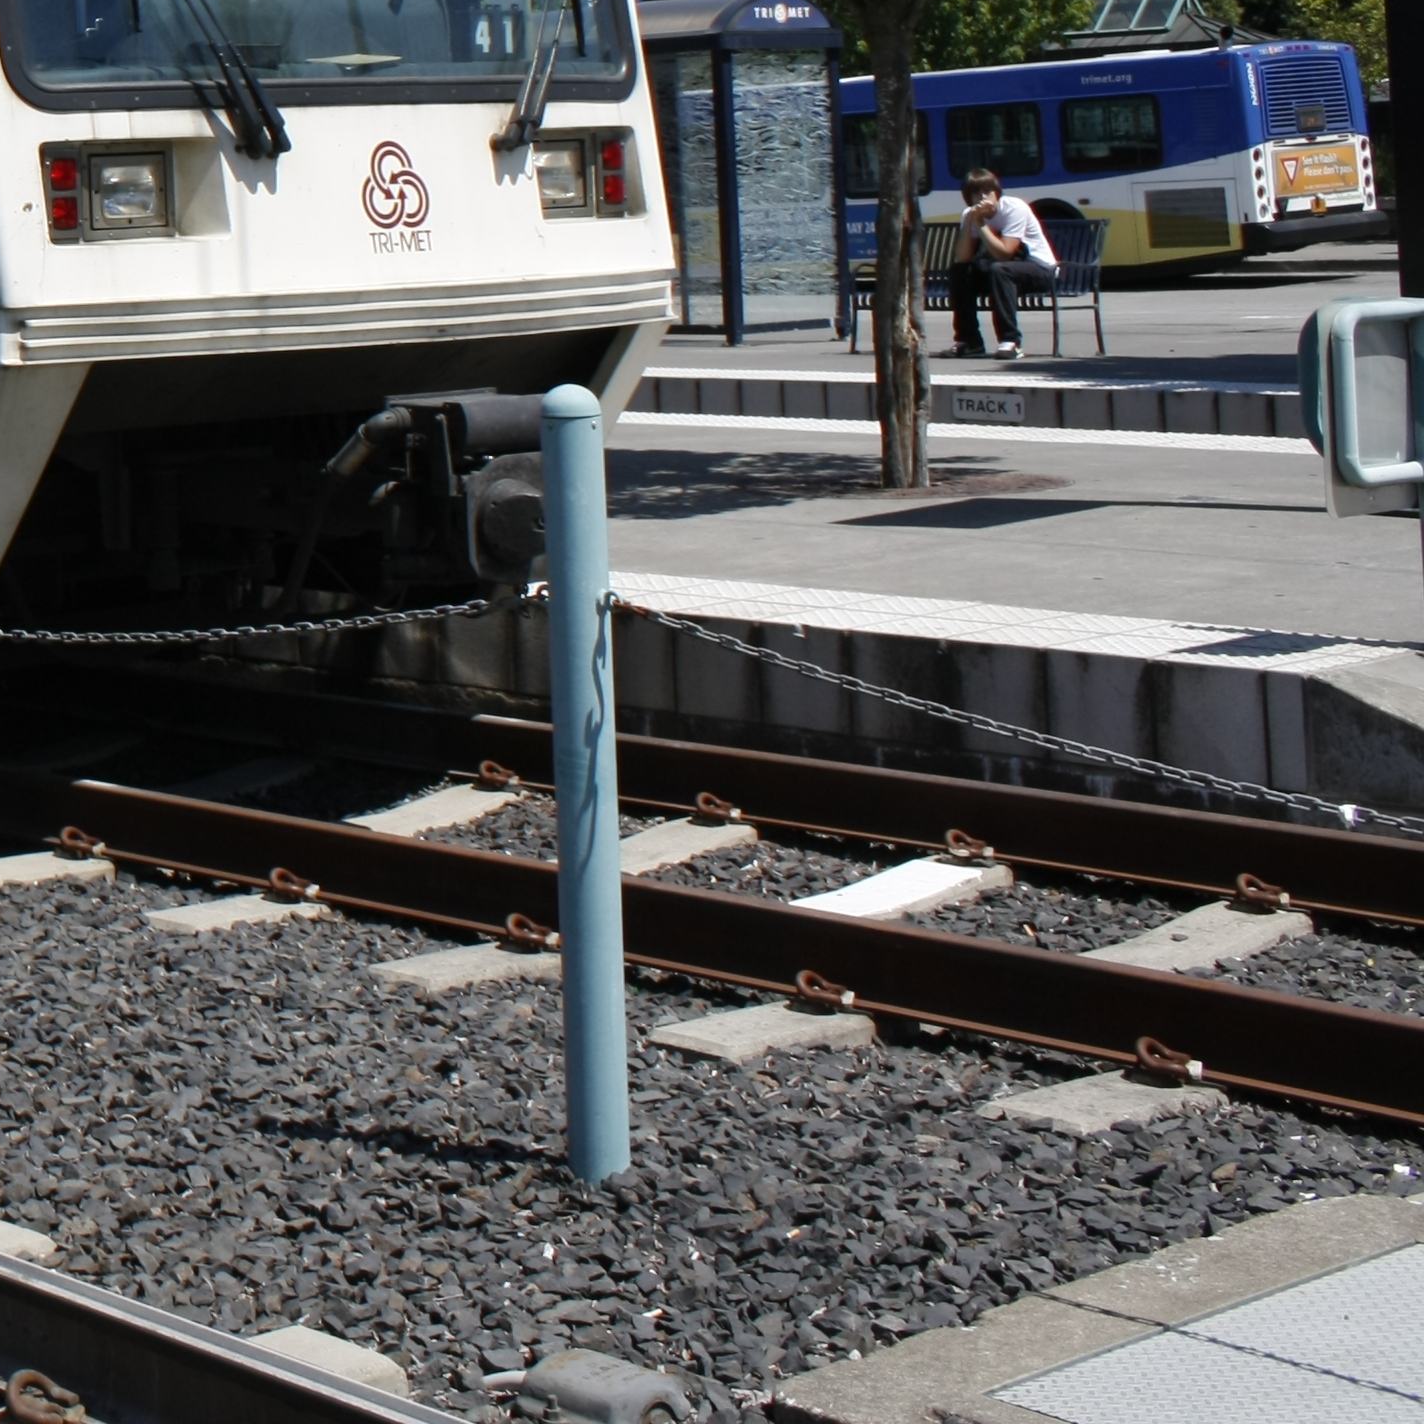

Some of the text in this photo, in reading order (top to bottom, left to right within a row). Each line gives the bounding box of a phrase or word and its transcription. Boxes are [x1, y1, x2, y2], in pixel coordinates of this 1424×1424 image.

[753, 6, 811, 19] TRI MET
[1080, 73, 1133, 85] trimet.org
[1302, 155, 1314, 166] See
[1303, 167, 1323, 177] Please
[368, 229, 433, 255] TRI-MET
[956, 398, 1022, 415] TRACK 1
